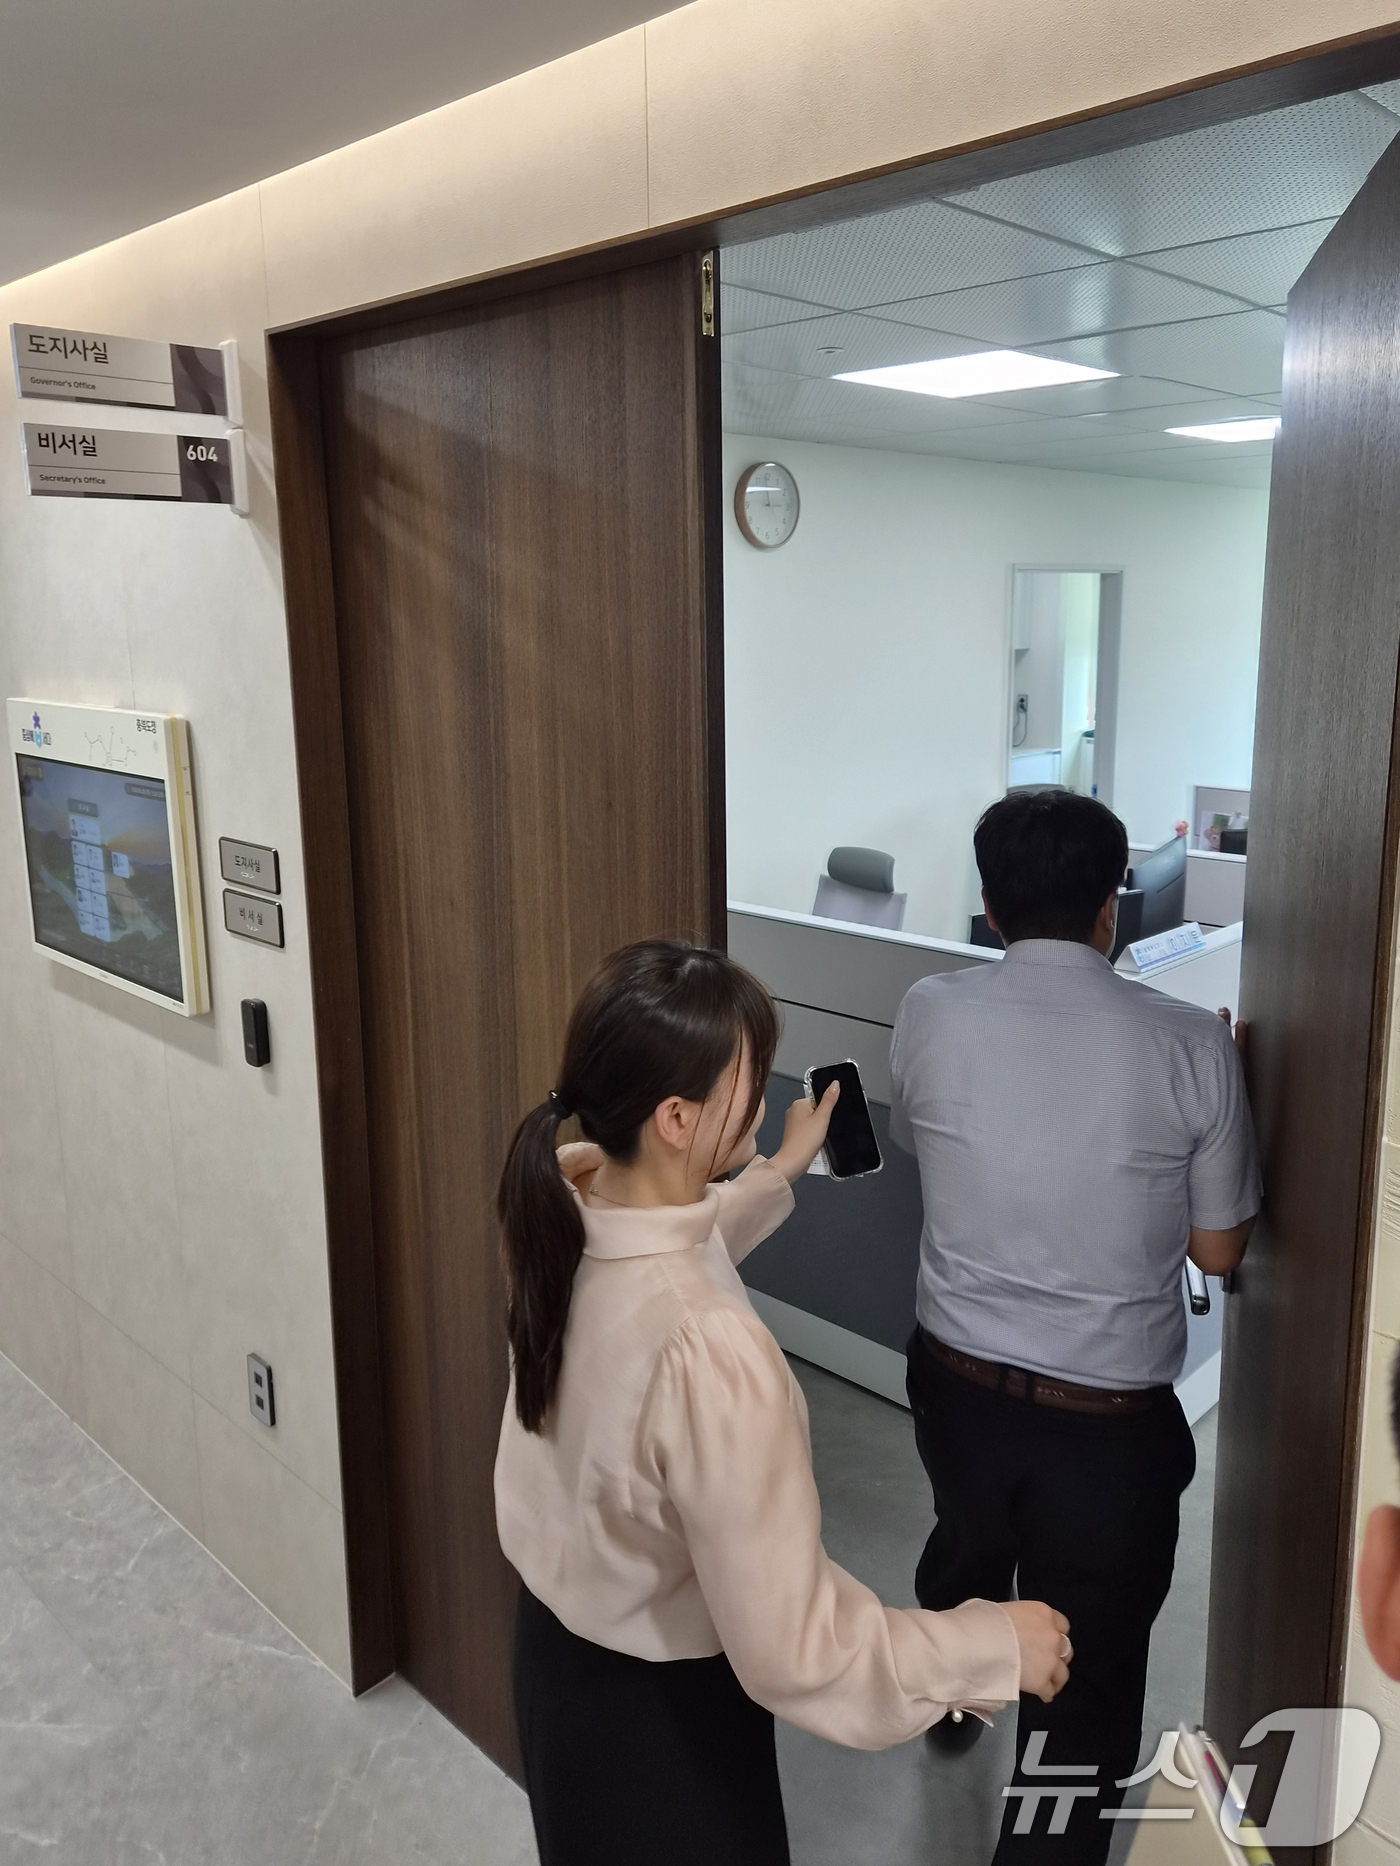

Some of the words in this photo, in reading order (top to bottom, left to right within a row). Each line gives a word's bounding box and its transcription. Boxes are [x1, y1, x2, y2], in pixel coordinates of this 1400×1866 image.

[28, 334, 109, 364] 도지사실
[30, 376, 73, 388] Governor's
[73, 381, 96, 391] Office
[37, 432, 98, 457] 비서실
[186, 445, 218, 462] 604
[39, 474, 82, 485] Secretary's
[84, 477, 106, 485] Office
[234, 855, 261, 873] 도지사실
